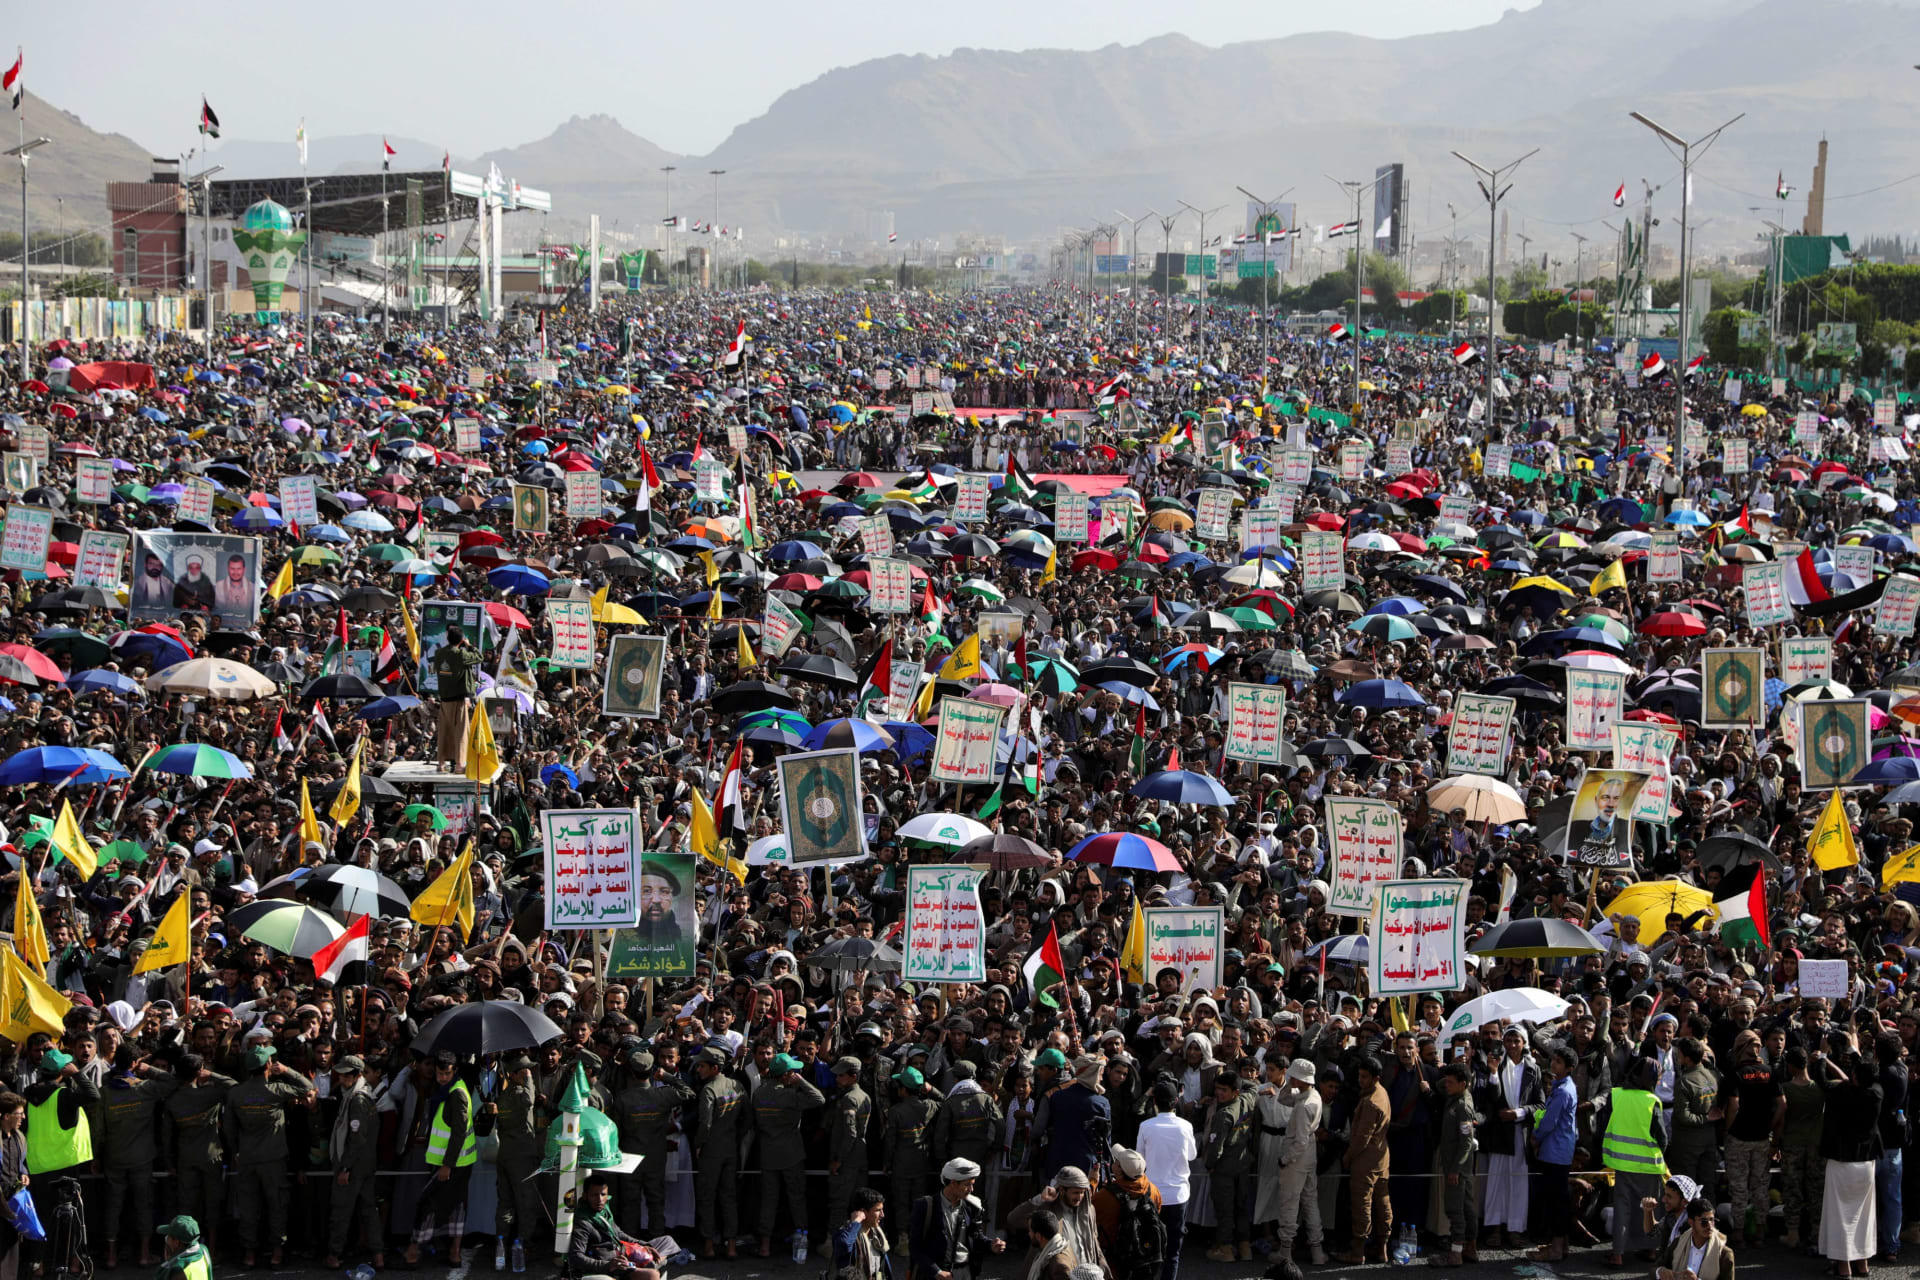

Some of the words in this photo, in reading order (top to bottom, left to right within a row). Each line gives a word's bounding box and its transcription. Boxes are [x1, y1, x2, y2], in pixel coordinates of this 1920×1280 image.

[946, 704, 997, 724] قاطعوا
[600, 816, 629, 837] الله
[1336, 806, 1370, 830] أكبر
[554, 816, 599, 842] أكبر
[555, 840, 594, 858] لأمريكا
[596, 840, 629, 858] الموت
[556, 861, 595, 879] لإسرائيل
[598, 860, 630, 877] الموت
[556, 880, 584, 897] اليهود
[586, 882, 602, 897] على
[606, 880, 631, 893] اللعنة
[912, 870, 956, 896] أكبر
[913, 896, 949, 912] لأمريكا
[1336, 885, 1364, 907] للإسلام
[1386, 888, 1456, 913] قاطعوا
[556, 898, 595, 921] للإسلام
[598, 896, 632, 920] النصر
[912, 917, 949, 934] لإسرائيل
[950, 918, 979, 932] الموت
[1151, 920, 1215, 942] قاطعوا
[1384, 917, 1422, 937] الأمريكية
[1422, 916, 1452, 937] البضائع
[652, 944, 675, 953] الشهيد
[912, 936, 937, 951] اليهود
[940, 938, 953, 952] على
[956, 936, 978, 949] اللعنة
[1416, 942, 1421, 957] و
[1150, 945, 1185, 965] الأمريكية
[1185, 946, 1214, 966] البضائع
[616, 956, 651, 974] شكر
[654, 956, 687, 973] فؤاد
[910, 954, 946, 976] للإسلام
[948, 953, 978, 976] النصر
